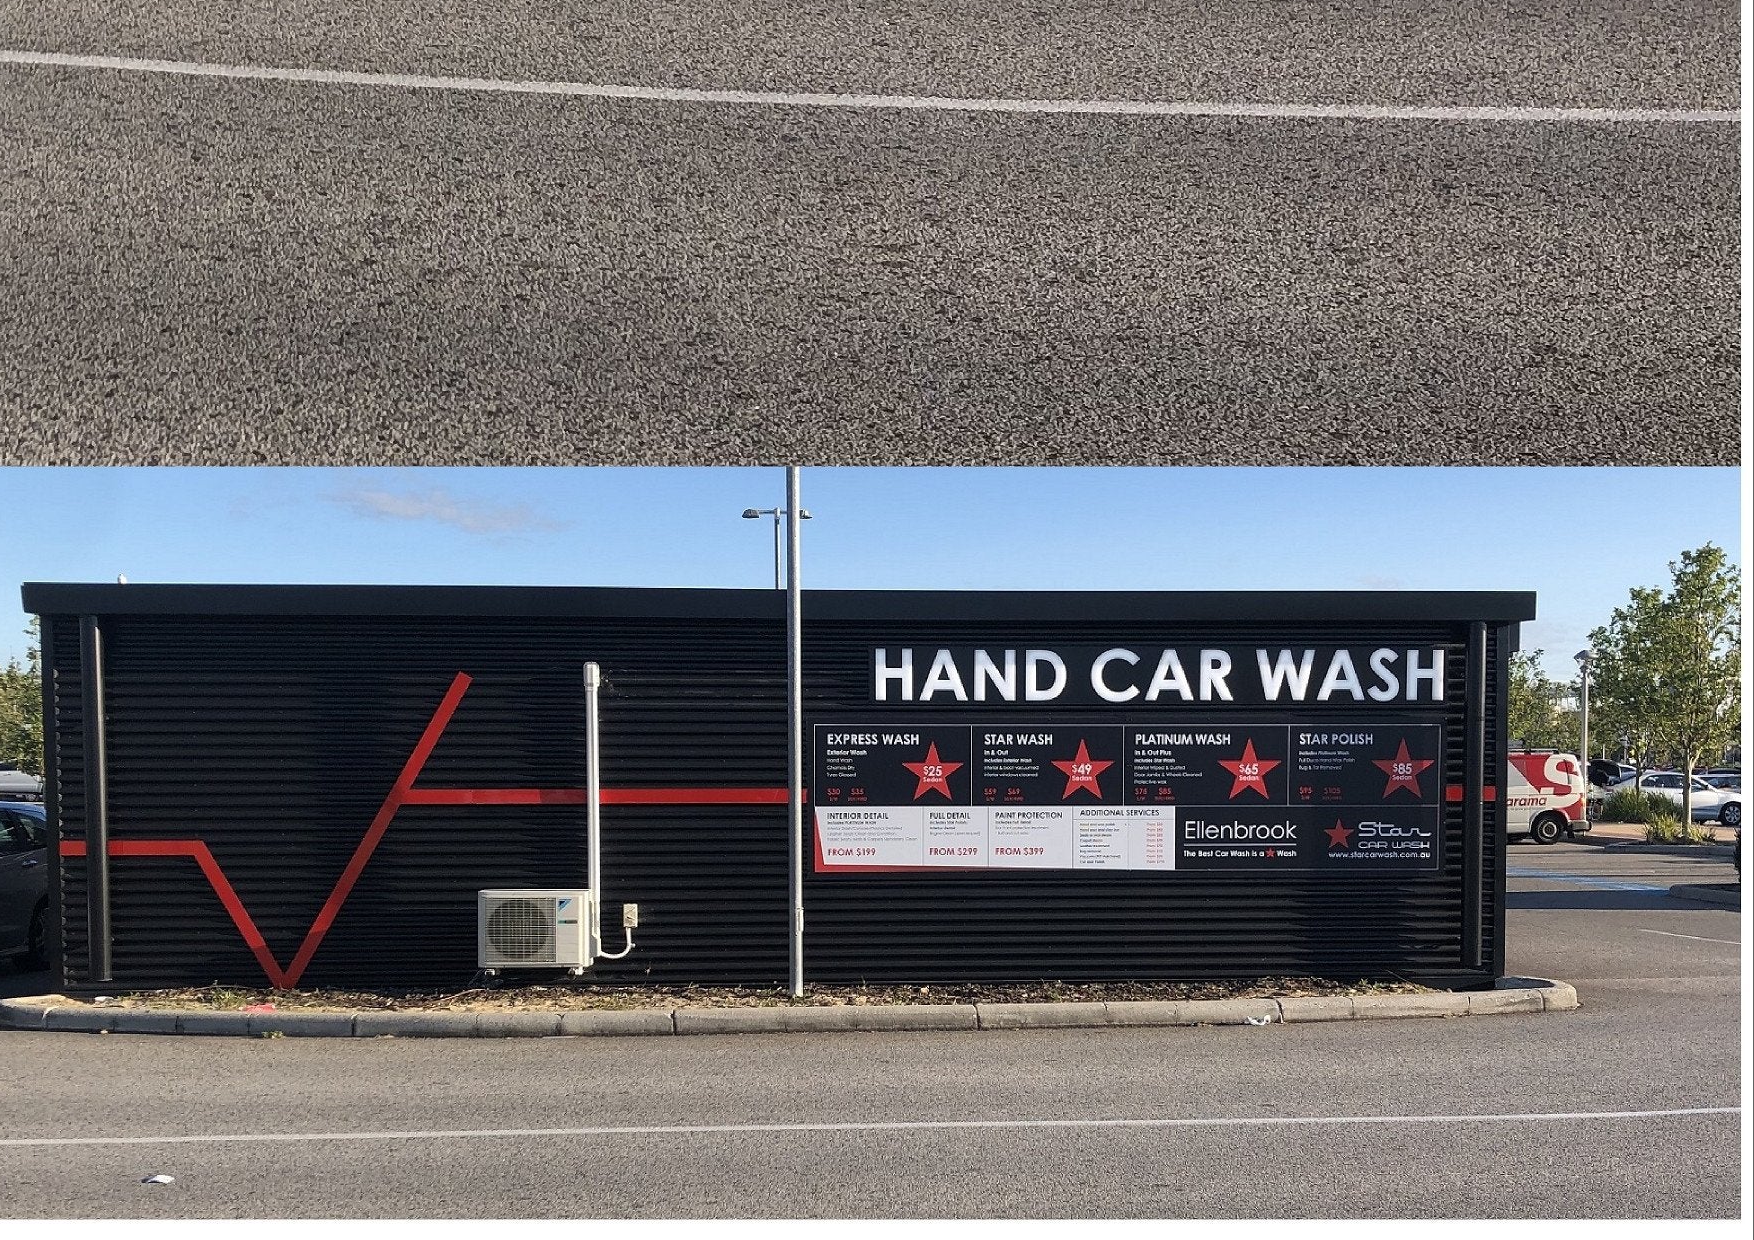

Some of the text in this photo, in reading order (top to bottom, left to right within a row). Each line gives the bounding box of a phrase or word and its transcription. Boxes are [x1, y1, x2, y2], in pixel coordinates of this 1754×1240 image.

[874, 648, 1445, 703] HAND CAR WASH
[827, 734, 920, 745] EXPRESS WASH
[984, 734, 1053, 745] STAR WASH
[1135, 734, 1230, 745] PLATINUM WASH
[1300, 733, 1373, 745] STAR POLISH
[923, 766, 942, 777] $25
[1072, 764, 1092, 775] $49
[1239, 764, 1258, 775] $65
[1393, 763, 1412, 775] $85
[1185, 820, 1296, 839] Ellenbrook
[1358, 822, 1431, 837] Star
[828, 848, 876, 857] FROM $199
[930, 848, 978, 856] FROM $299
